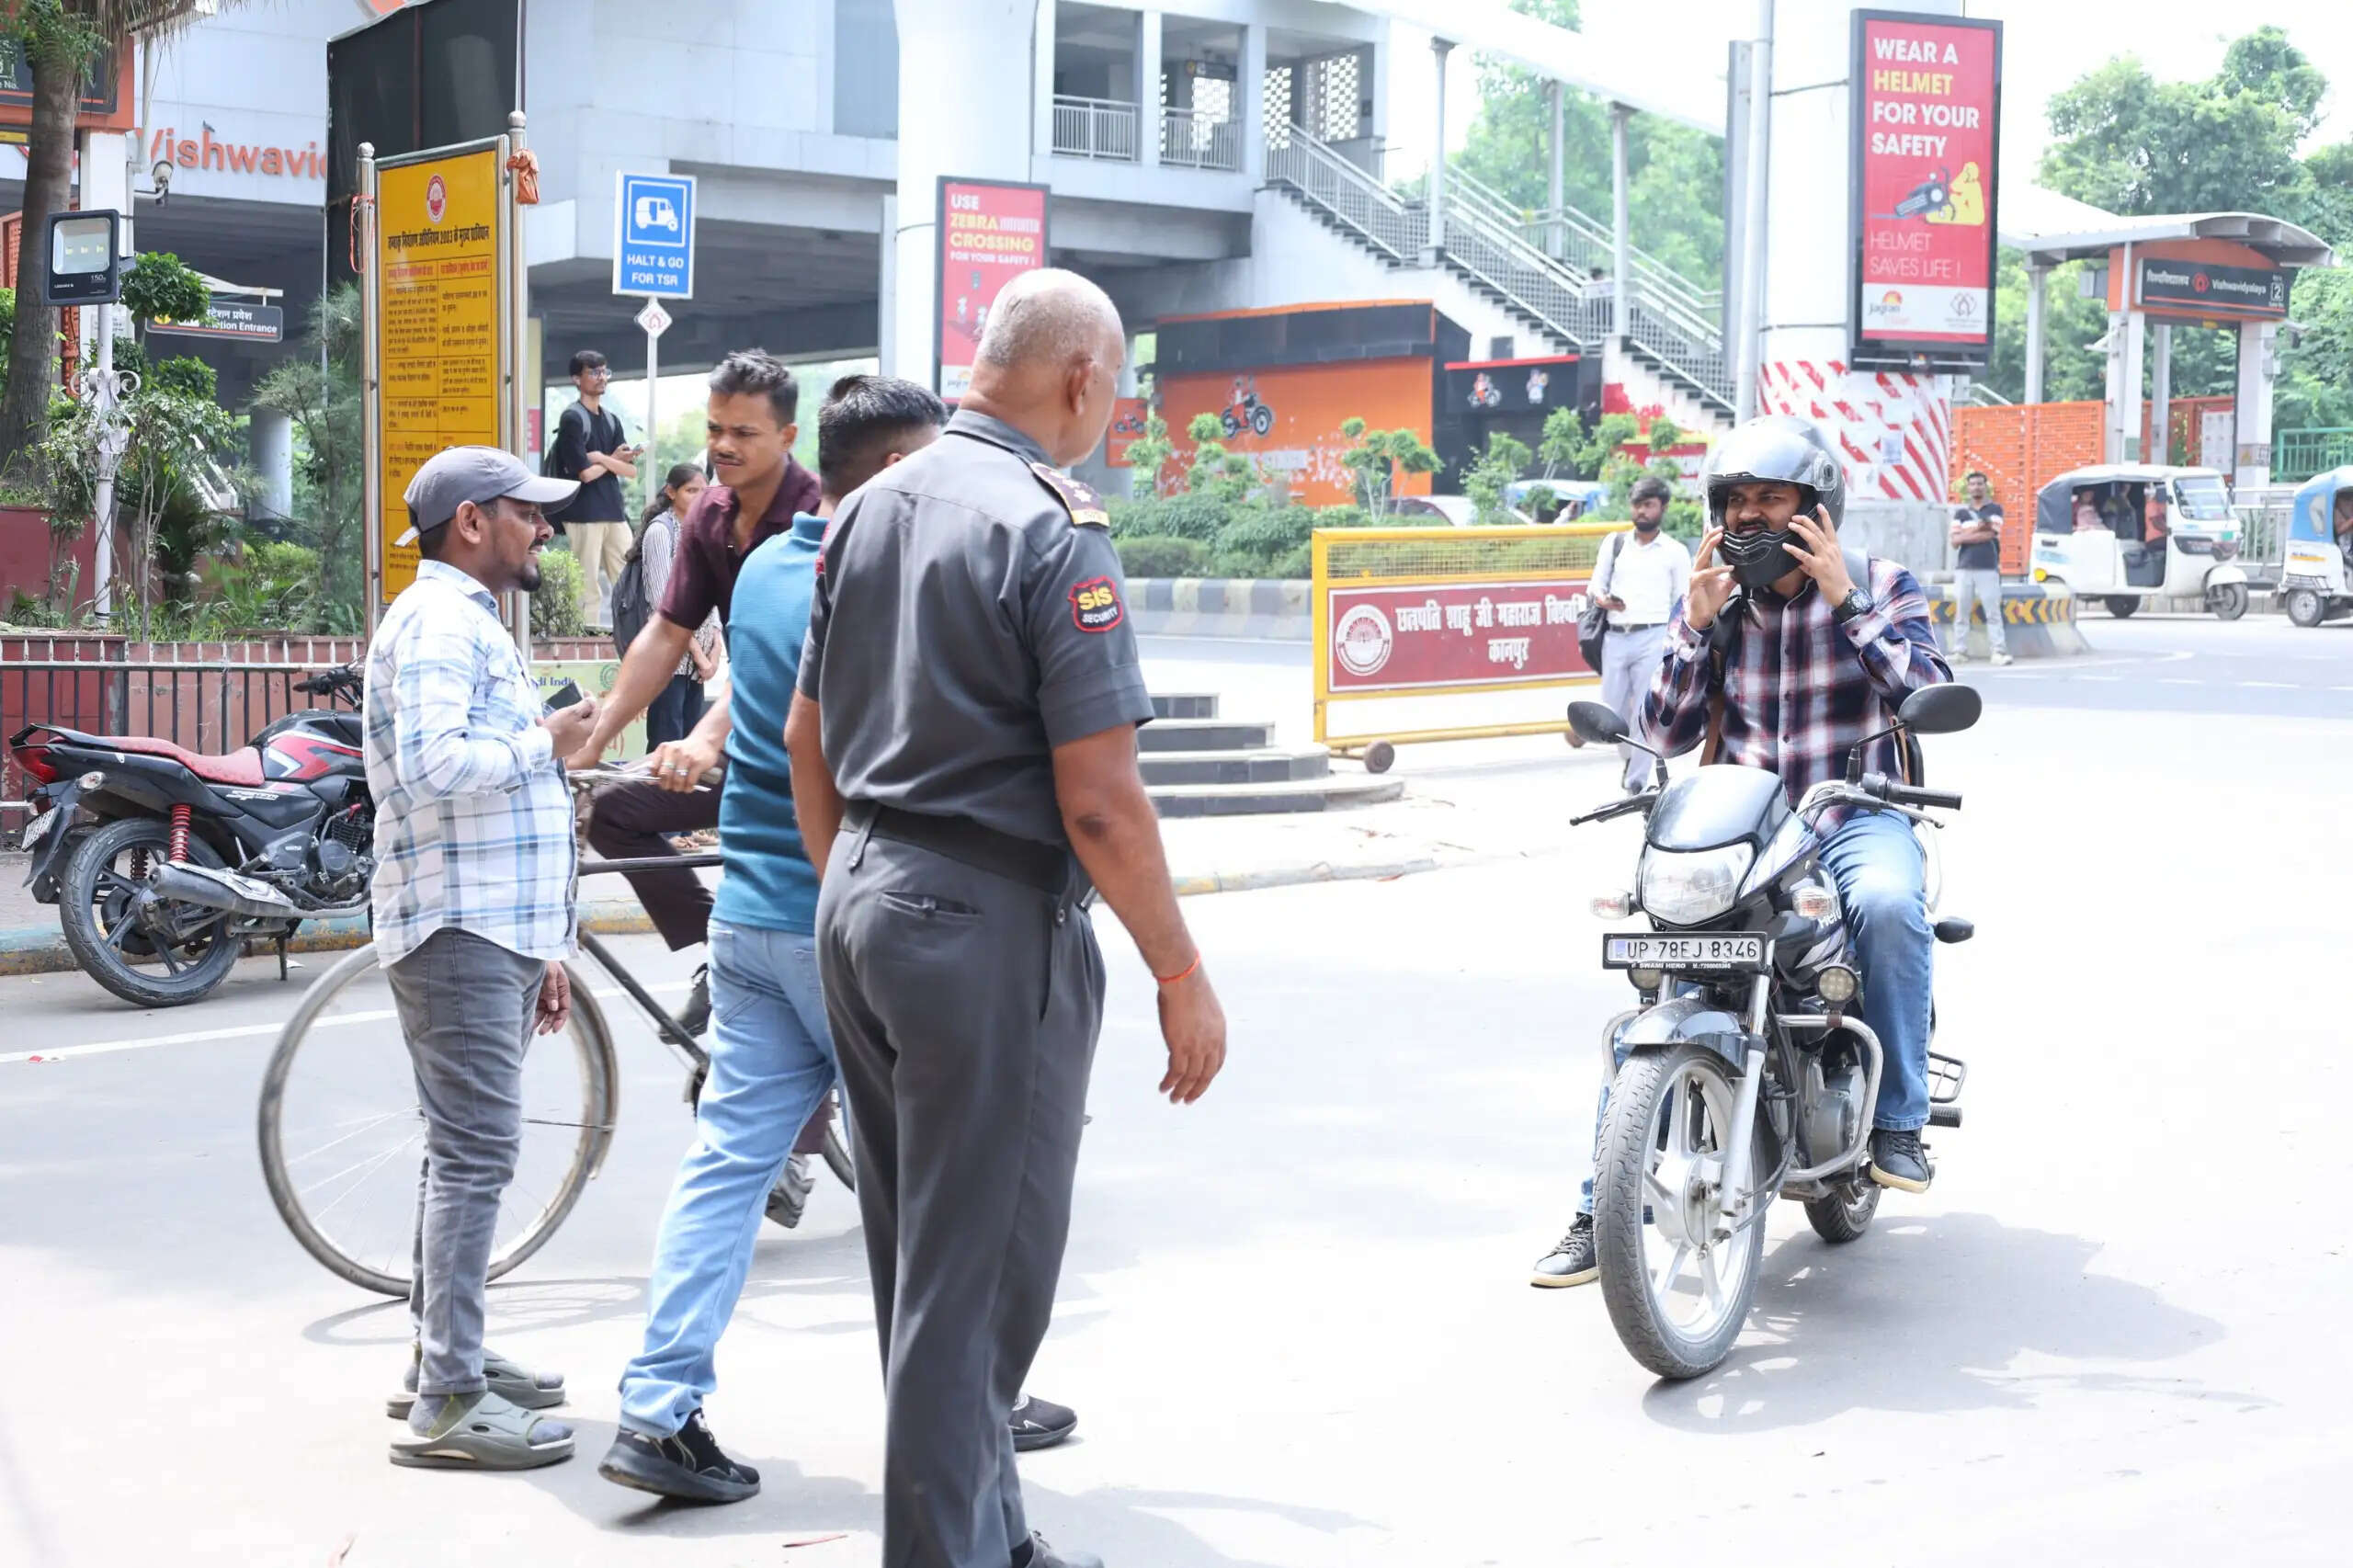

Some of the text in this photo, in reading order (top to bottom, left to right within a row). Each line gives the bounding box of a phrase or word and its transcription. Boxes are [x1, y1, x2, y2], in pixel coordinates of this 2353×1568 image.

[1874, 38, 1959, 64] WEAR A
[1873, 69, 1953, 96] HELMET
[1872, 100, 1980, 129] FOR YOUR
[1870, 131, 1948, 157] SAFETY
[950, 194, 979, 210] USE
[950, 212, 998, 231] ZEBRA
[950, 232, 1035, 252] CROSSING
[1870, 230, 1933, 251] HELMET
[627, 254, 685, 269] HALT & GO
[1870, 256, 1919, 277] SAVES
[1923, 258, 1951, 278] LIFE
[631, 272, 678, 287] FOR TSR
[239, 323, 278, 333] Entrance
[1445, 605, 1473, 636] शाहू
[1473, 597, 1494, 628] जी
[1495, 601, 1542, 627] महाराज
[1487, 637, 1530, 670] कानपुर
[1627, 940, 1757, 958] UP 78EJ 8346
